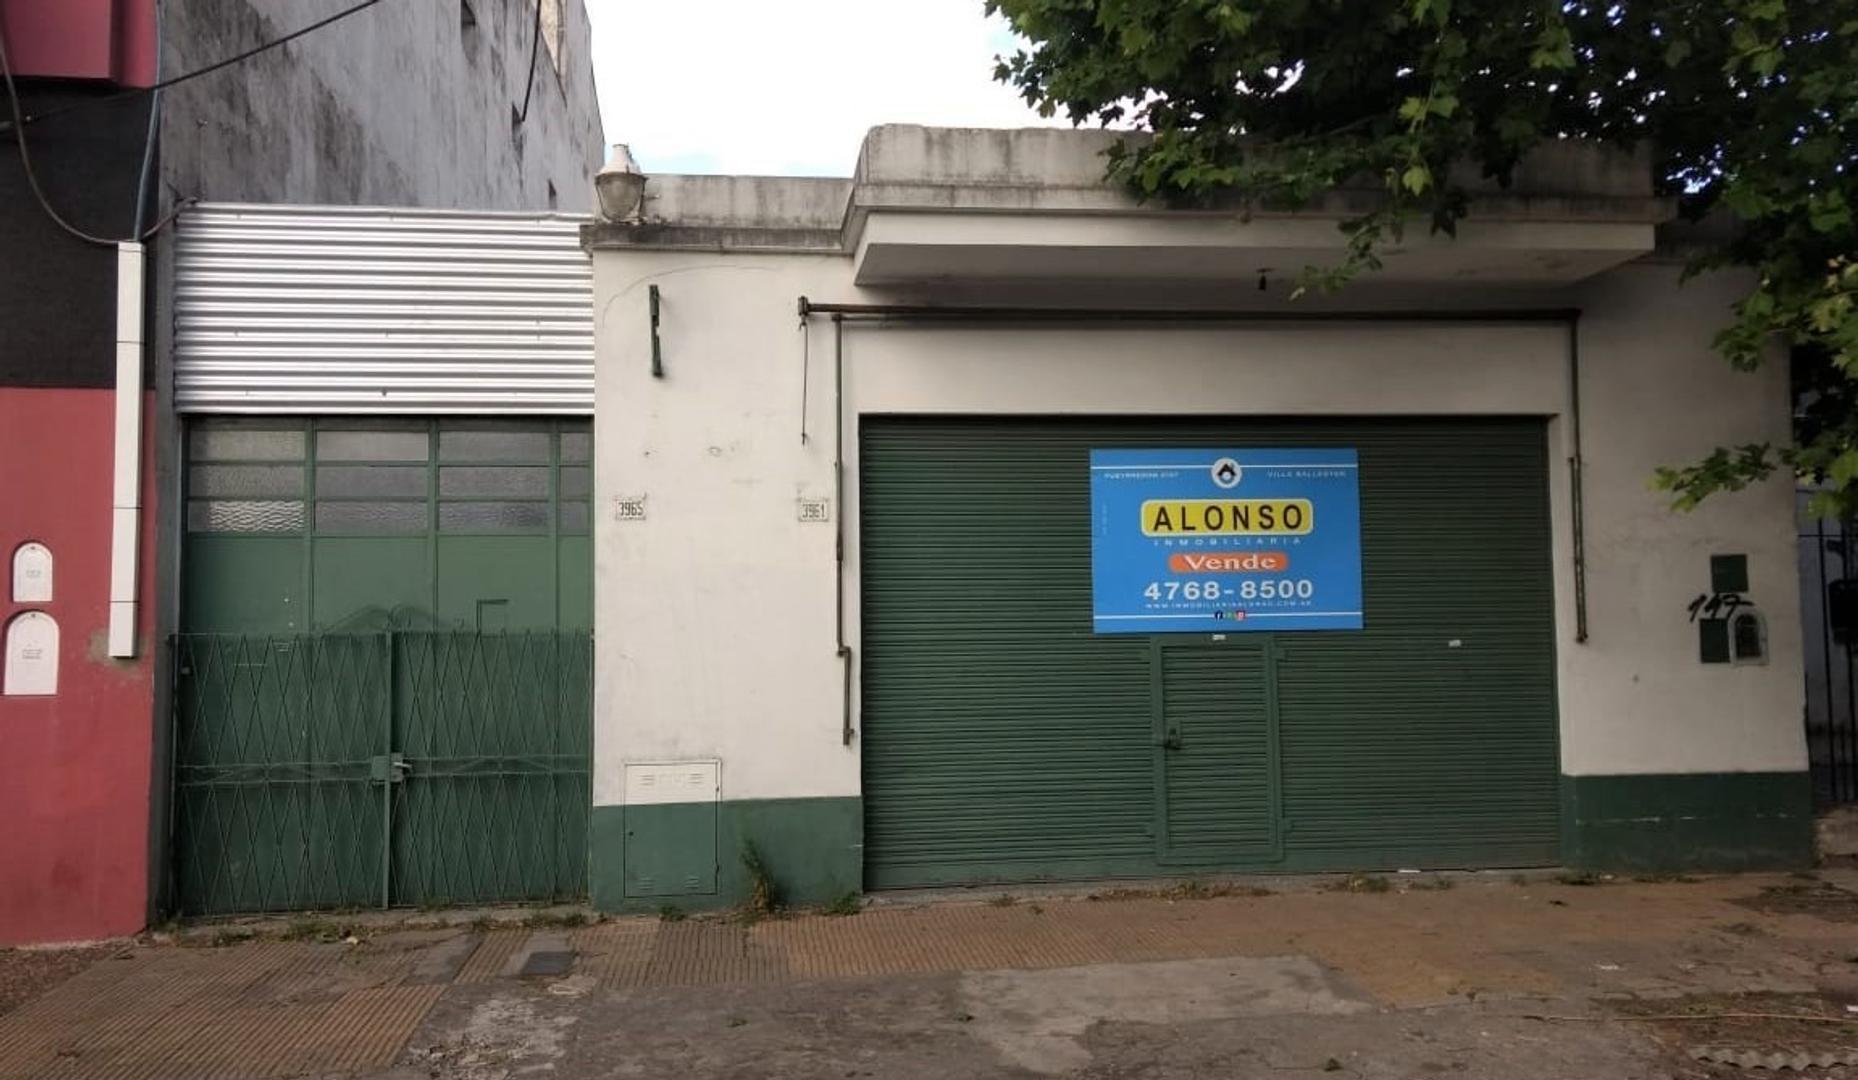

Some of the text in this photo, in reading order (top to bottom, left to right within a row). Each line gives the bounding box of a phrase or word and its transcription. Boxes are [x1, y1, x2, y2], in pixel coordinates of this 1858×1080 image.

[619, 501, 643, 516] 3965
[802, 503, 825, 518] 3961
[1152, 503, 1302, 531] ALONSO
[1153, 537, 1301, 547] INMOBILIARIA
[1183, 554, 1277, 570] Vende
[1143, 579, 1313, 600] 4768-8500
